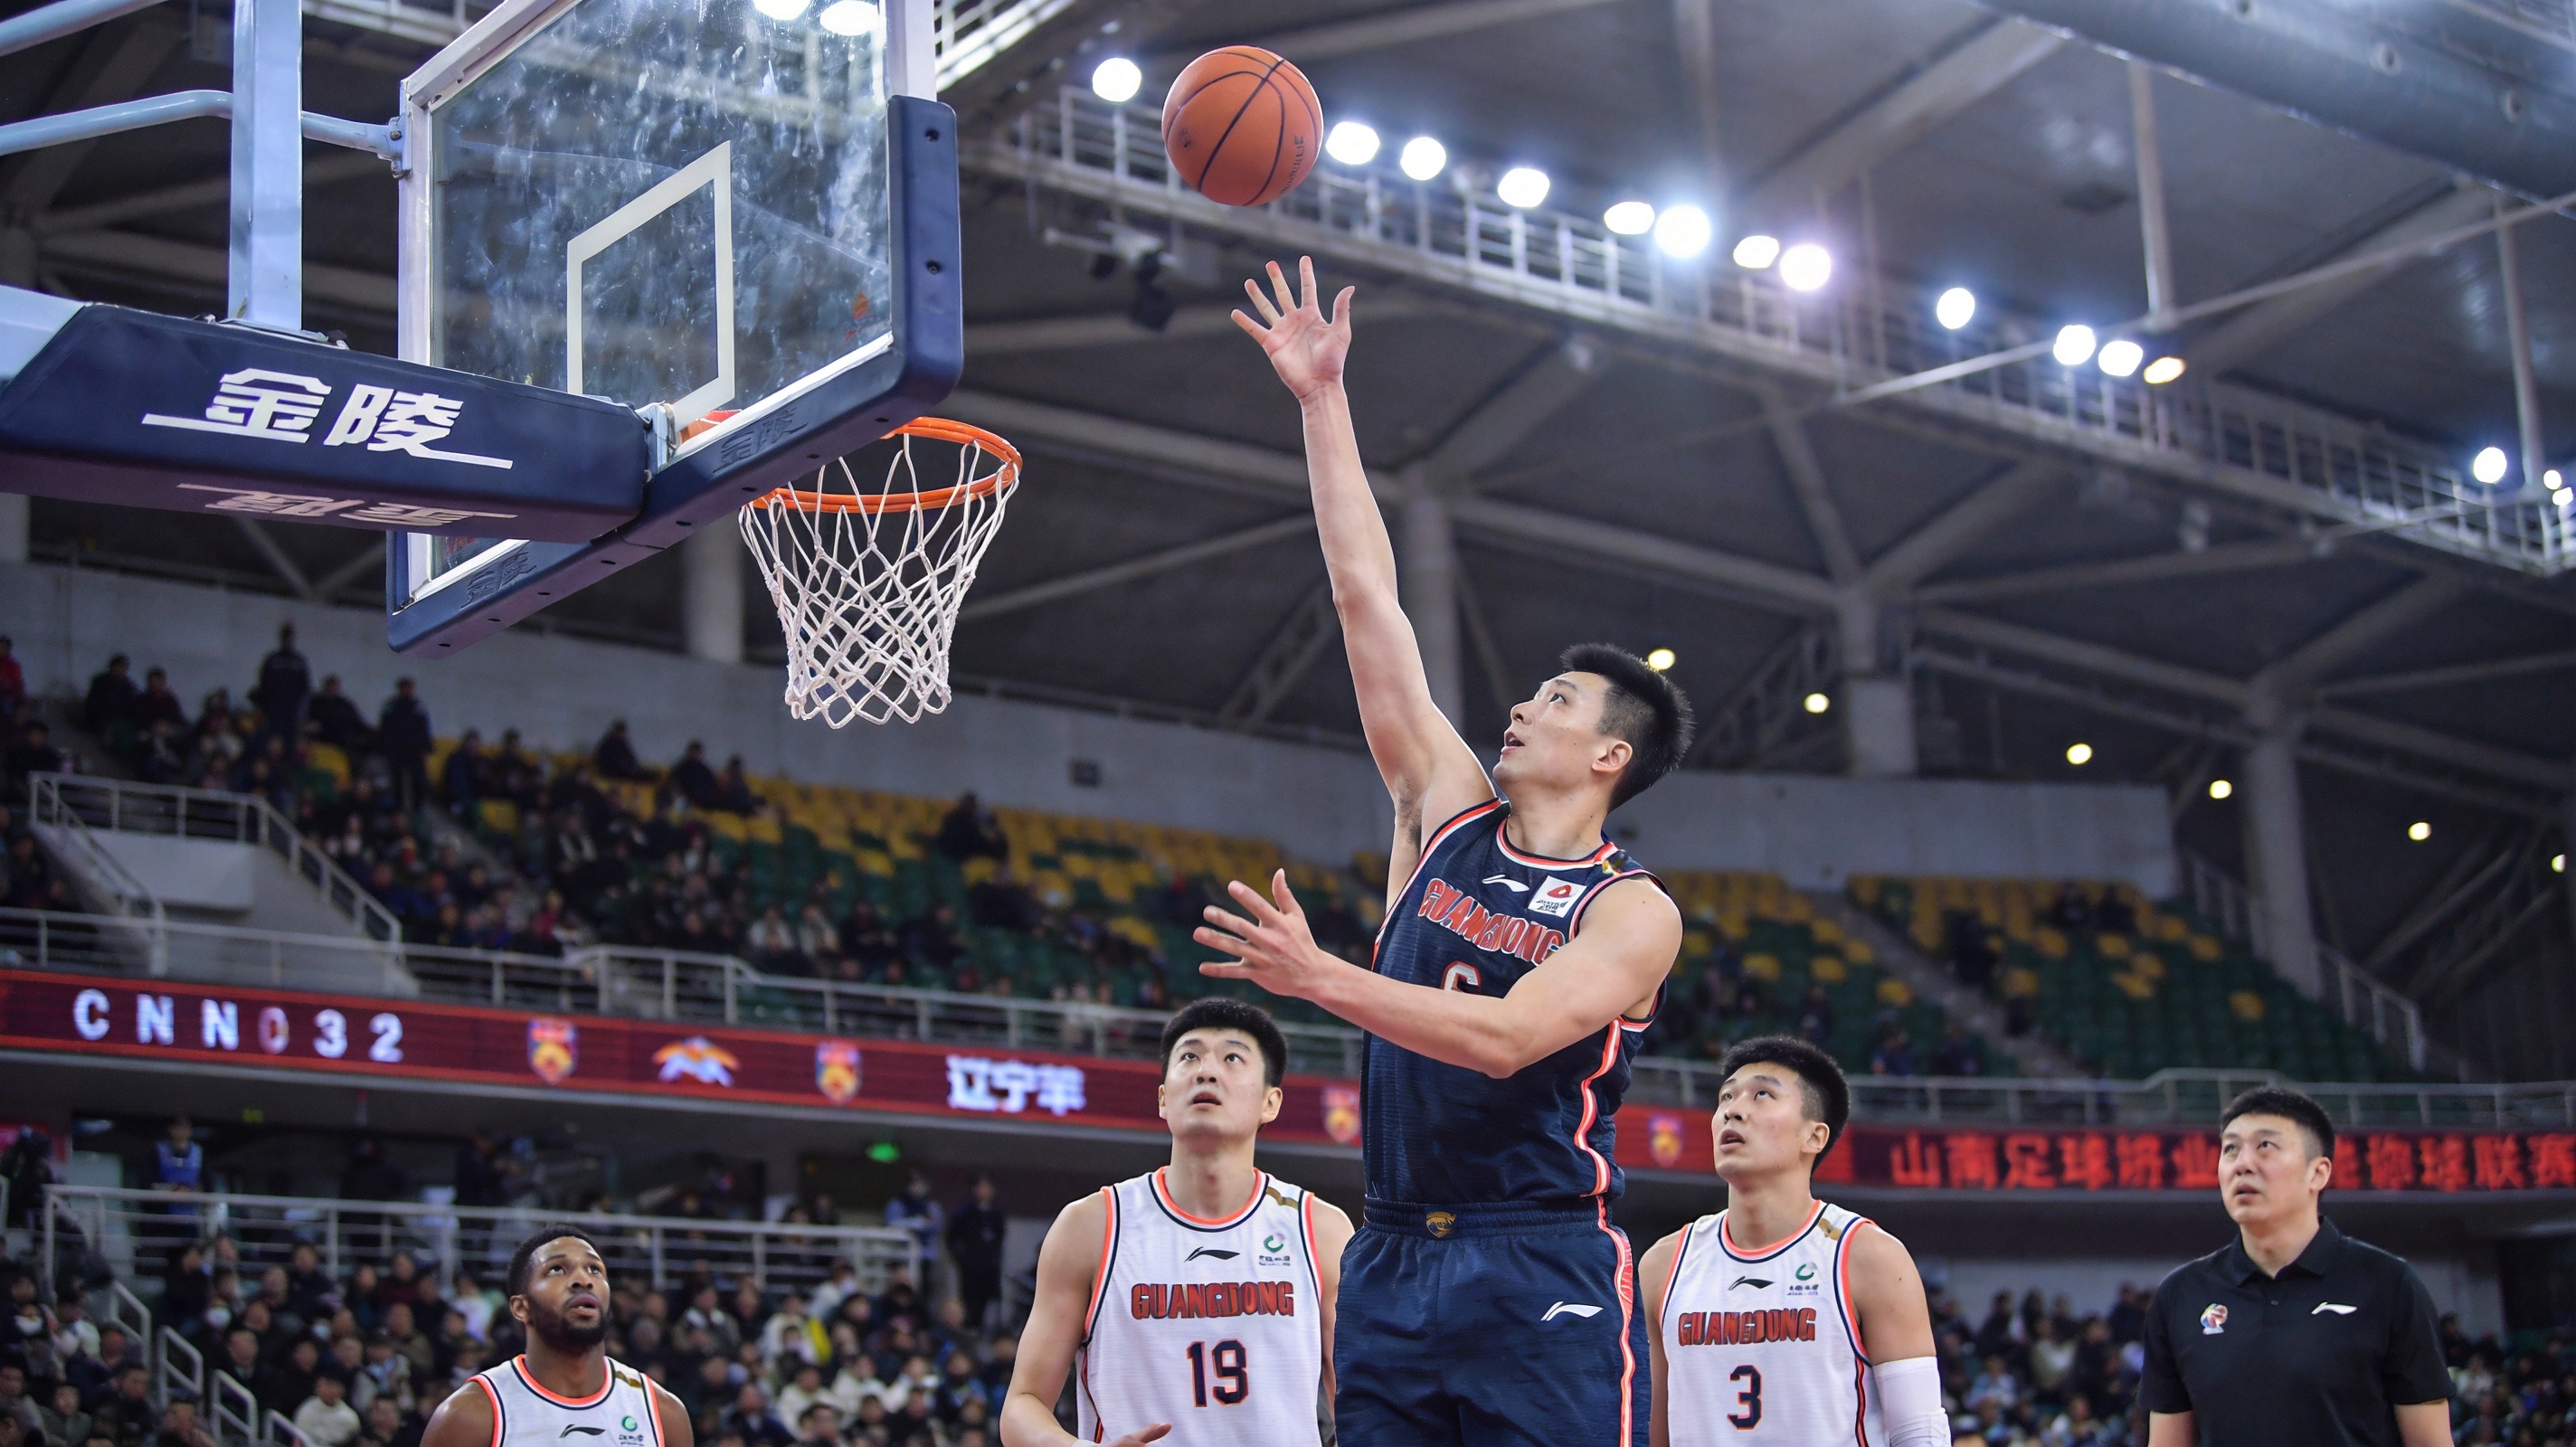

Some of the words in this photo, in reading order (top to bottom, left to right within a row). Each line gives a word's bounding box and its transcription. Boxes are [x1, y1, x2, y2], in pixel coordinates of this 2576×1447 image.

[142, 367, 513, 469] 金陵
[1131, 1281, 1294, 1319] GUANGDONG
[1187, 1339, 1249, 1408] 19
[1727, 1365, 1762, 1430] 3
